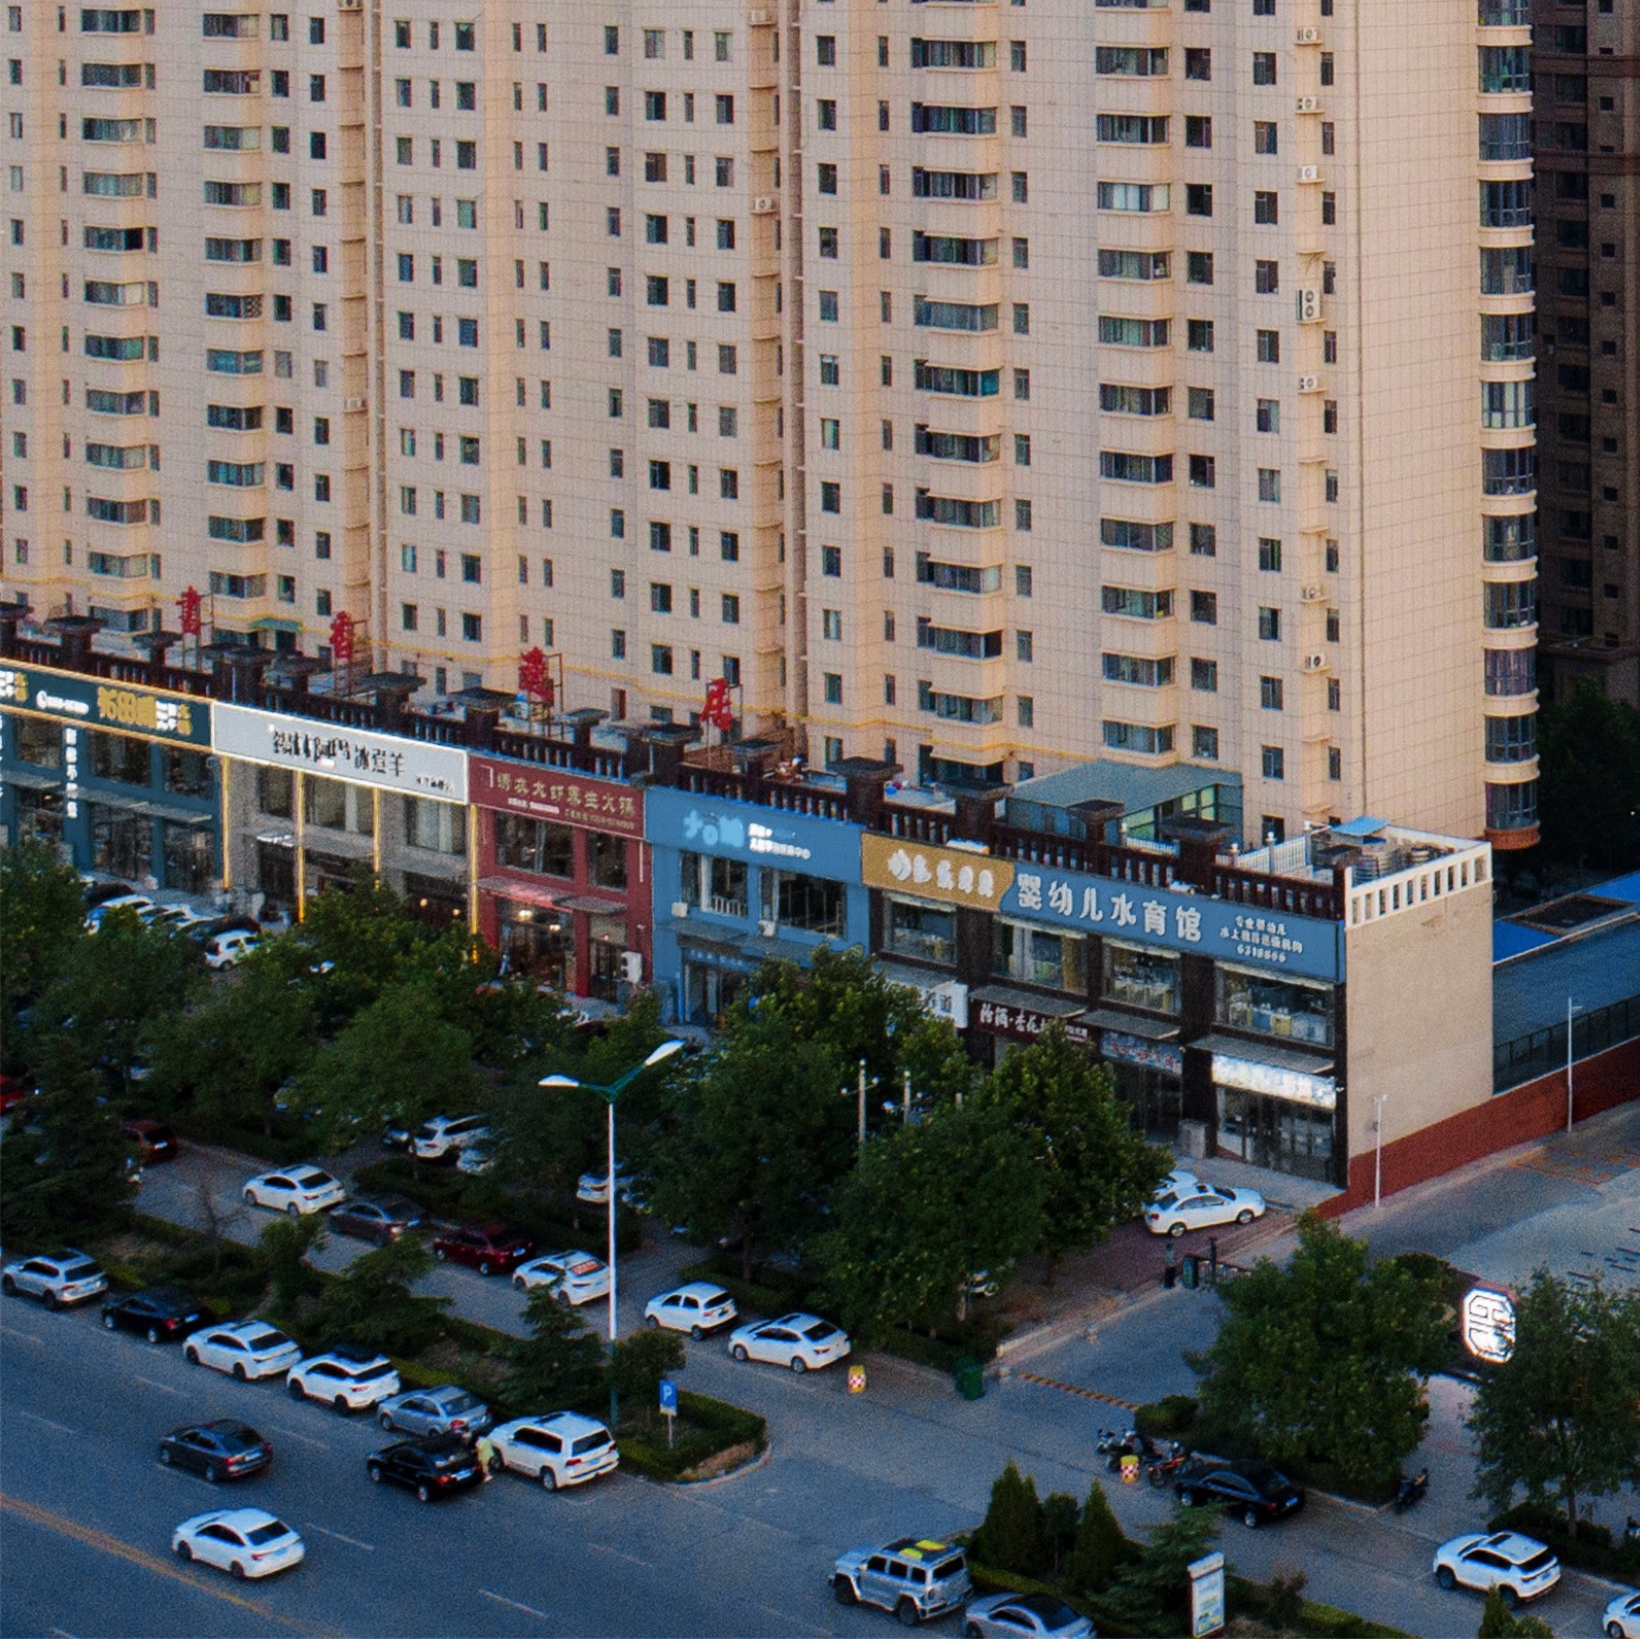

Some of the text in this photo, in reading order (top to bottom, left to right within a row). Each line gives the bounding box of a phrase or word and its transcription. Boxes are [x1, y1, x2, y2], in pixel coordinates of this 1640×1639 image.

[1017, 873, 1203, 943] 婴幼儿水育馆
